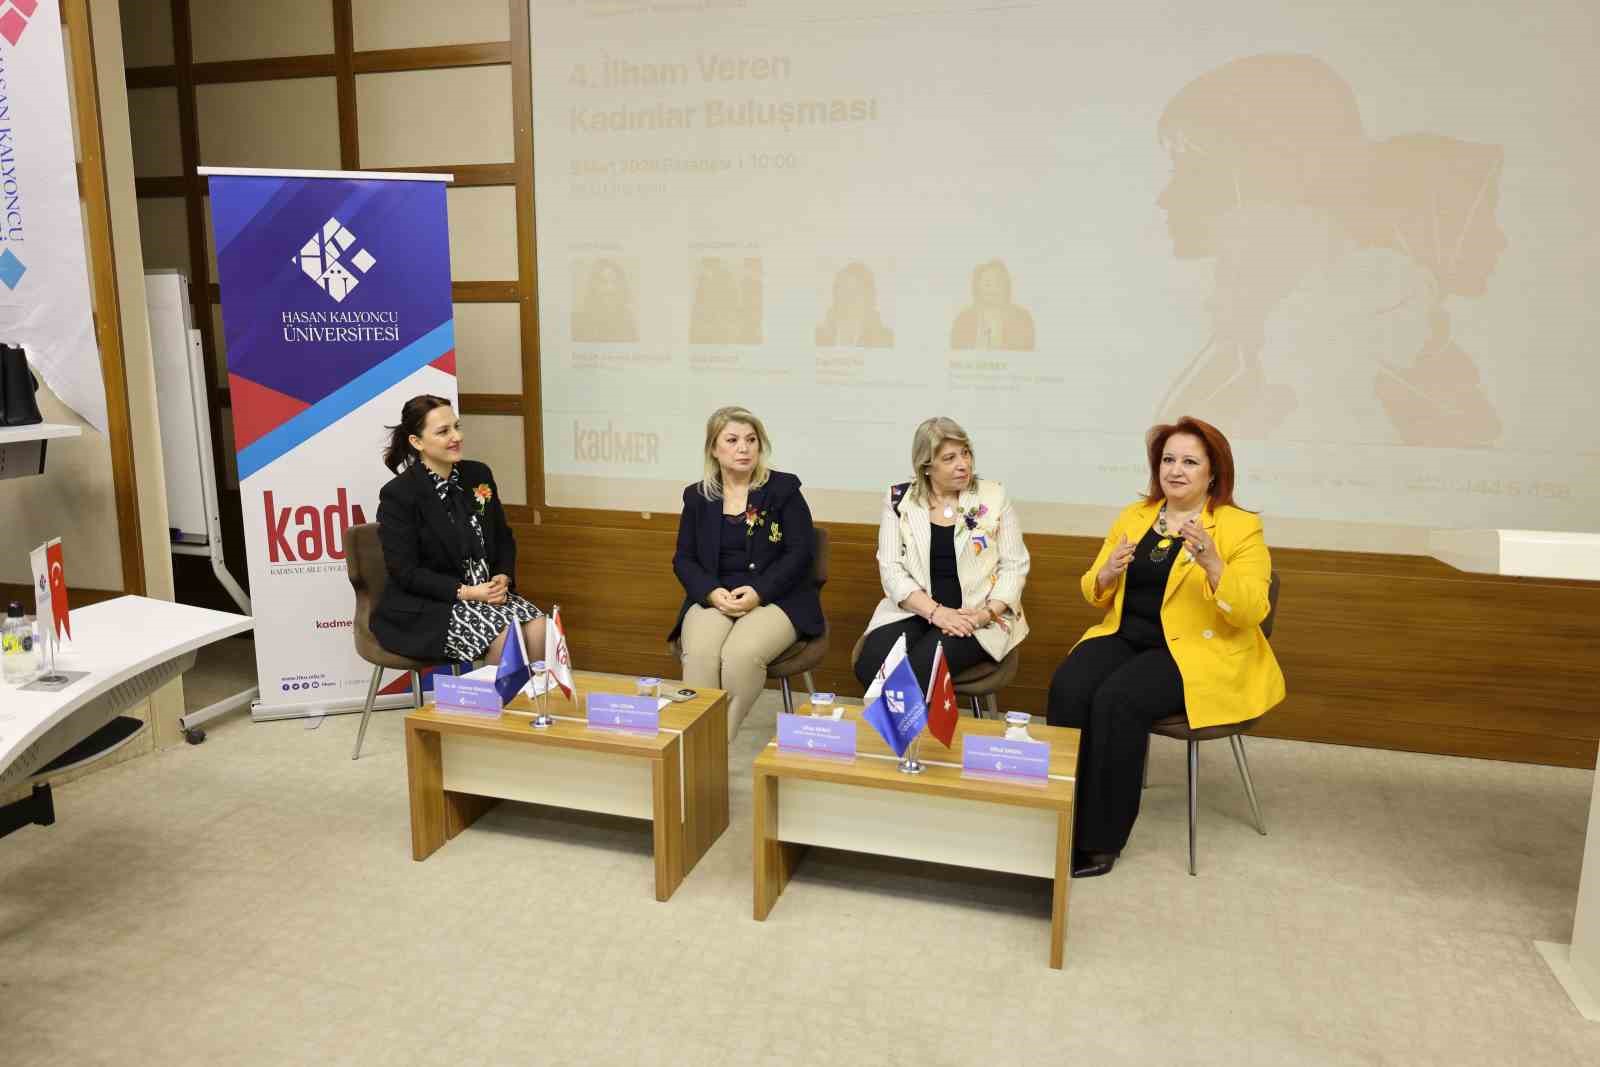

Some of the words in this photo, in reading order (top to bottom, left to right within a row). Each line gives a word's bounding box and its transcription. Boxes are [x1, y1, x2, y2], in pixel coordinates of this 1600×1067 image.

[600, 48, 689, 87] İlham
[696, 54, 792, 84] Veren
[568, 103, 697, 131] Kadınlar
[704, 95, 877, 135] Buluşması
[281, 311, 327, 323] HASAN
[330, 311, 399, 323] KALYONCU
[283, 323, 400, 342] ÜNİVERSİTESİ
[316, 618, 353, 630] kadme
